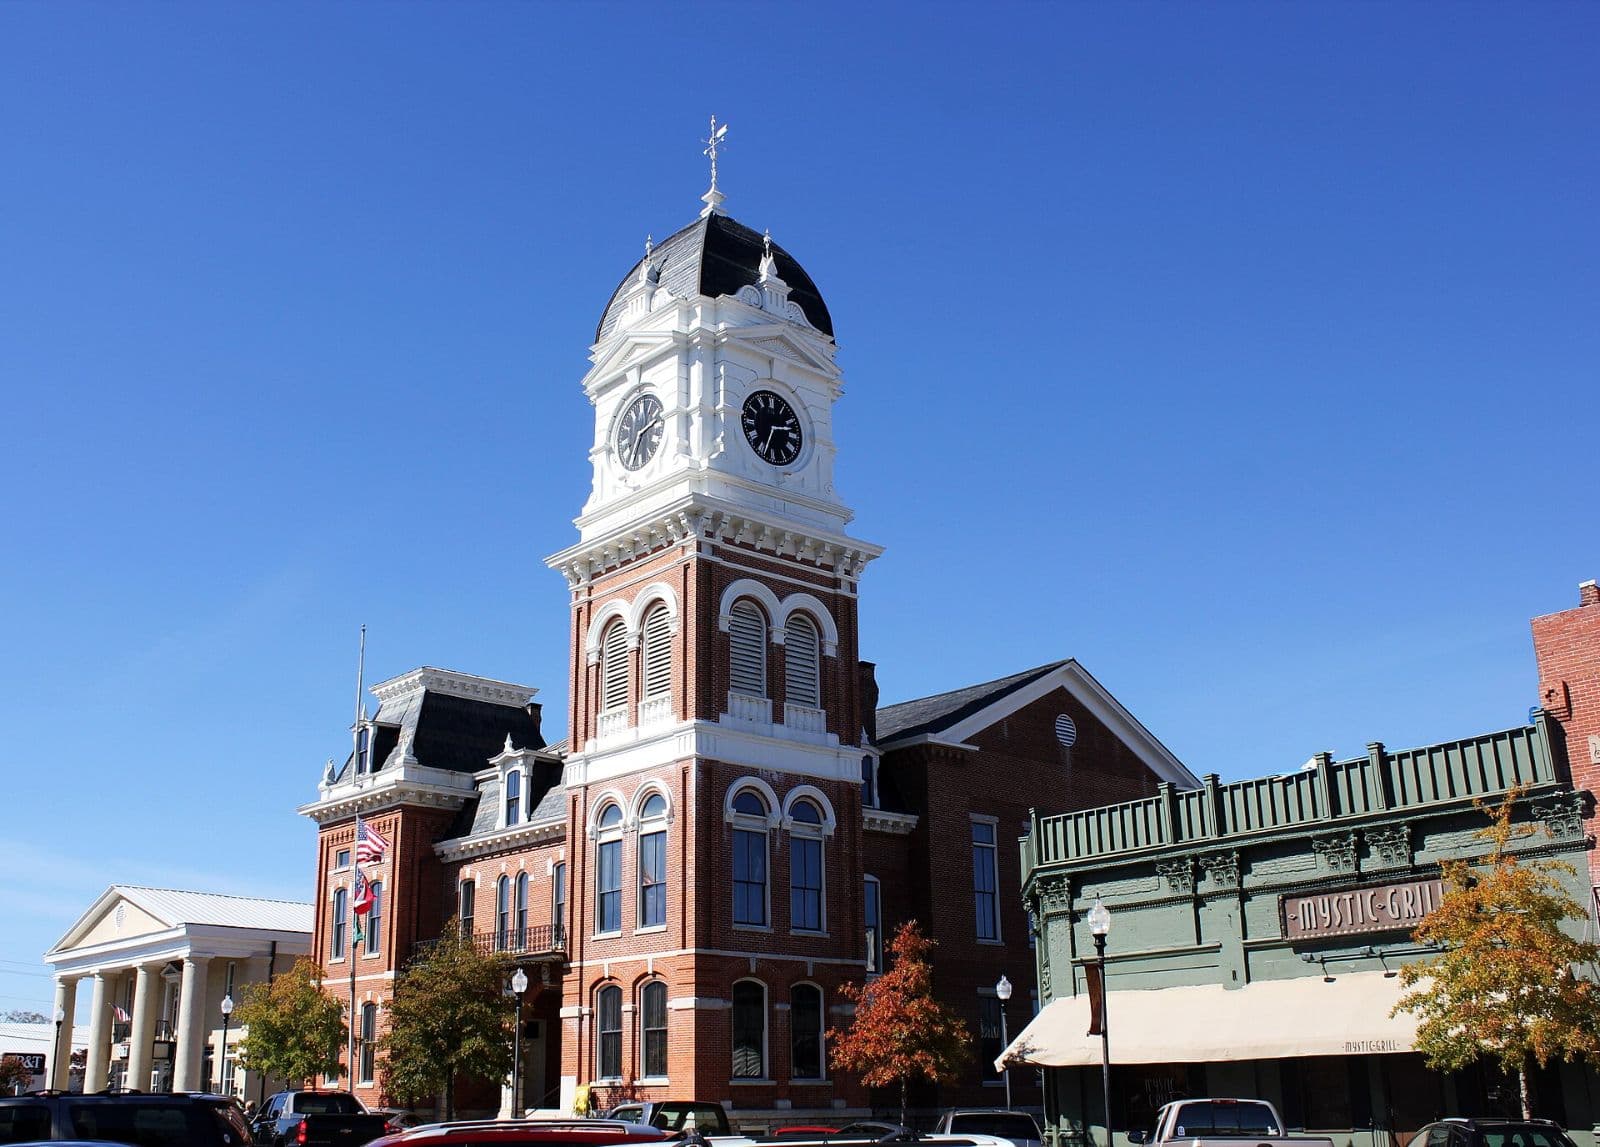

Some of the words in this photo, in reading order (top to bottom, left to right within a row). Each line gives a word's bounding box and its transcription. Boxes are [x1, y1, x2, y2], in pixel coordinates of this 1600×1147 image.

[1298, 891, 1379, 931] MYSTIC
[1345, 1041, 1376, 1052] MYSTIC
[1376, 1040, 1398, 1051] GRILL
